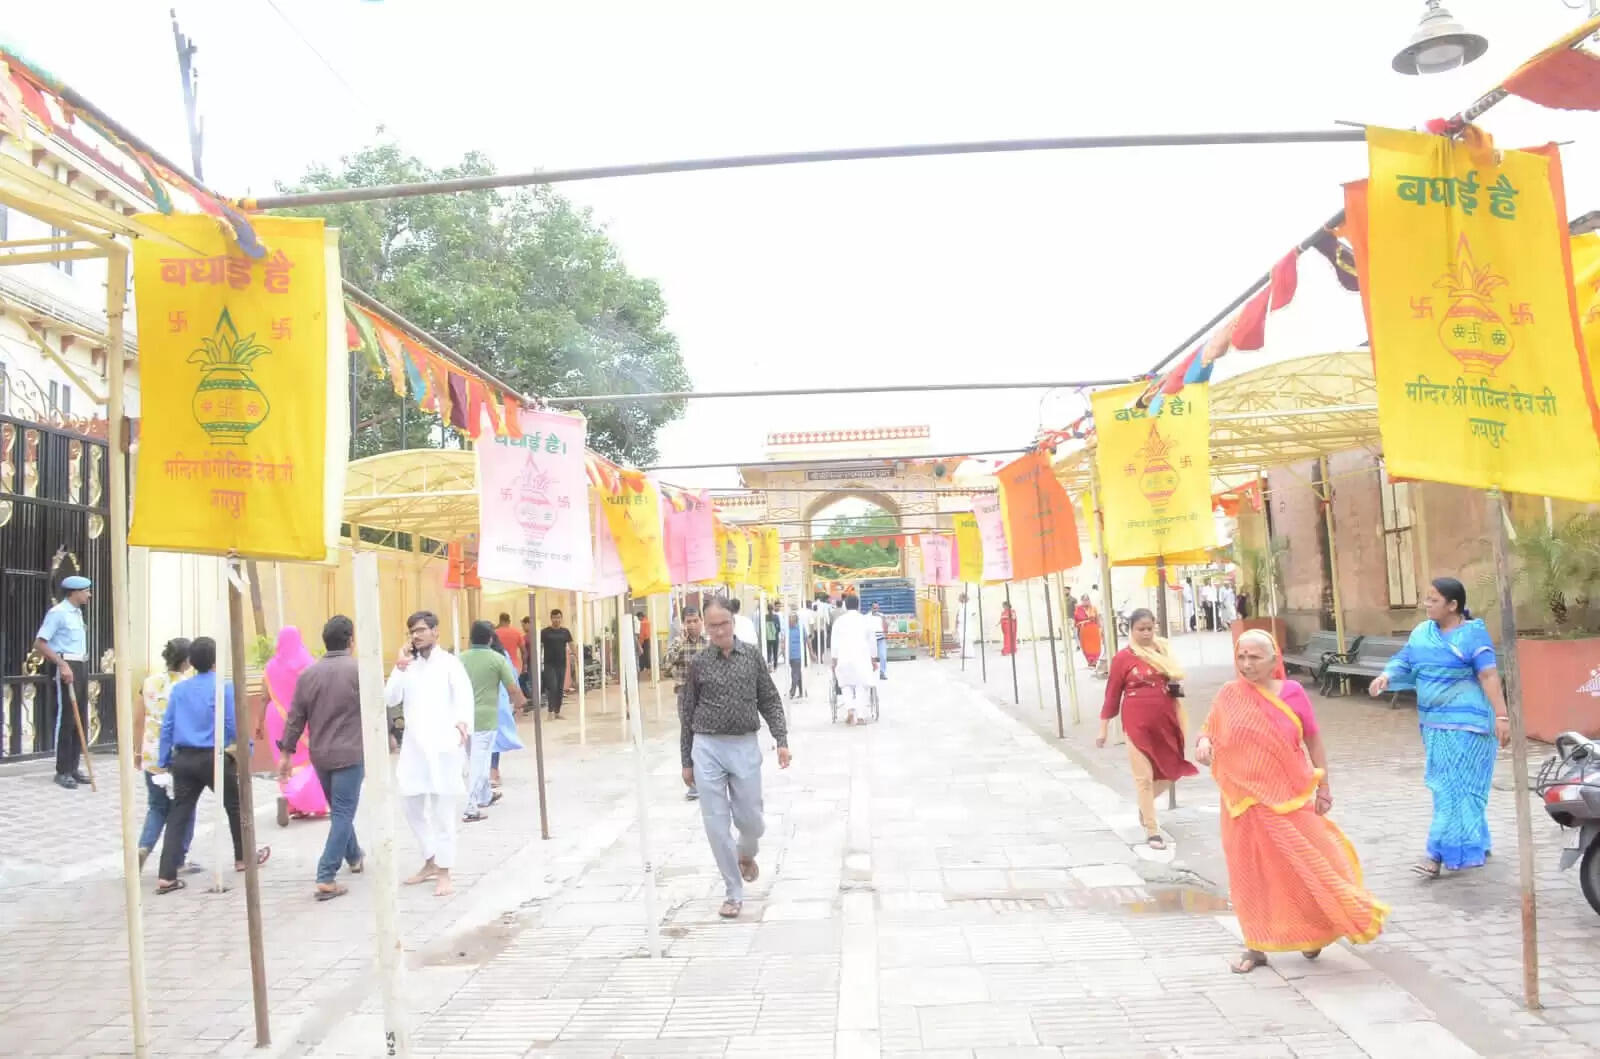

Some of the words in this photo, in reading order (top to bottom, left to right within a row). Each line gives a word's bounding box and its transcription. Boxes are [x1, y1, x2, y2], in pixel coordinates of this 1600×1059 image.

[1396, 170, 1480, 216] बधाई
[1486, 173, 1519, 220] है
[263, 248, 294, 294] है
[1451, 376, 1468, 406] श्री
[1511, 384, 1534, 414] देव
[1535, 387, 1557, 416] जी
